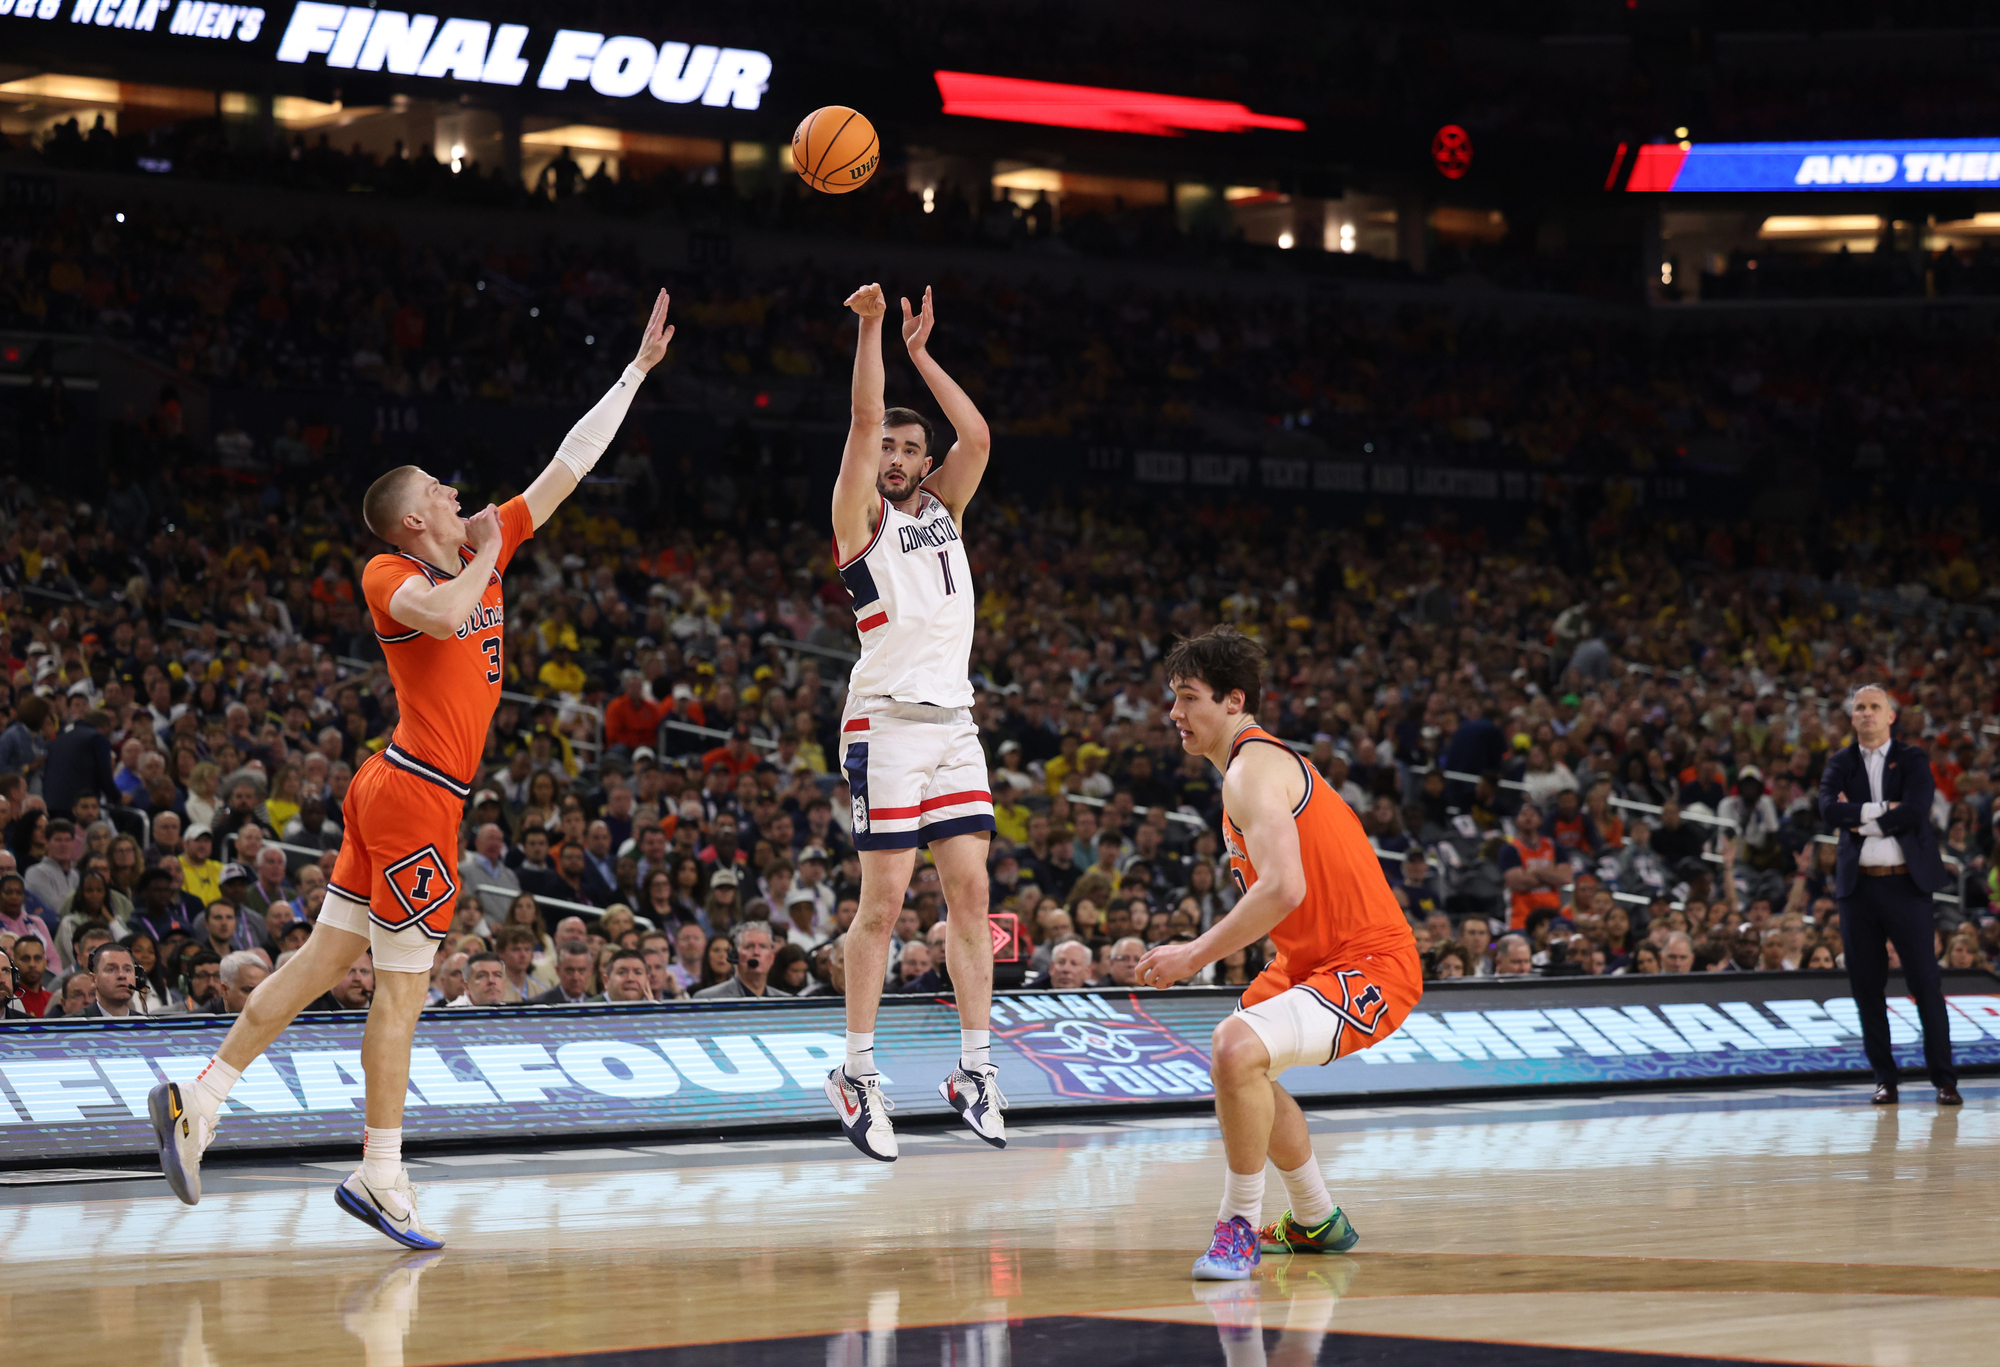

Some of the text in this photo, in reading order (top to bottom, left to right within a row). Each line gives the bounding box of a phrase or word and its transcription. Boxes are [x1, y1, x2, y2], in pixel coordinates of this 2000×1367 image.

[168, 0, 267, 42] MEN'S
[276, 1, 773, 110] FINAL FOUR
[1794, 153, 1898, 185] AND
[1260, 458, 1307, 490] TEXT
[937, 550, 956, 596] 11
[481, 635, 501, 684] 3
[410, 865, 435, 901] I
[0, 1033, 894, 1123] FINALFOUR
[1063, 1059, 1215, 1096] FOUR
